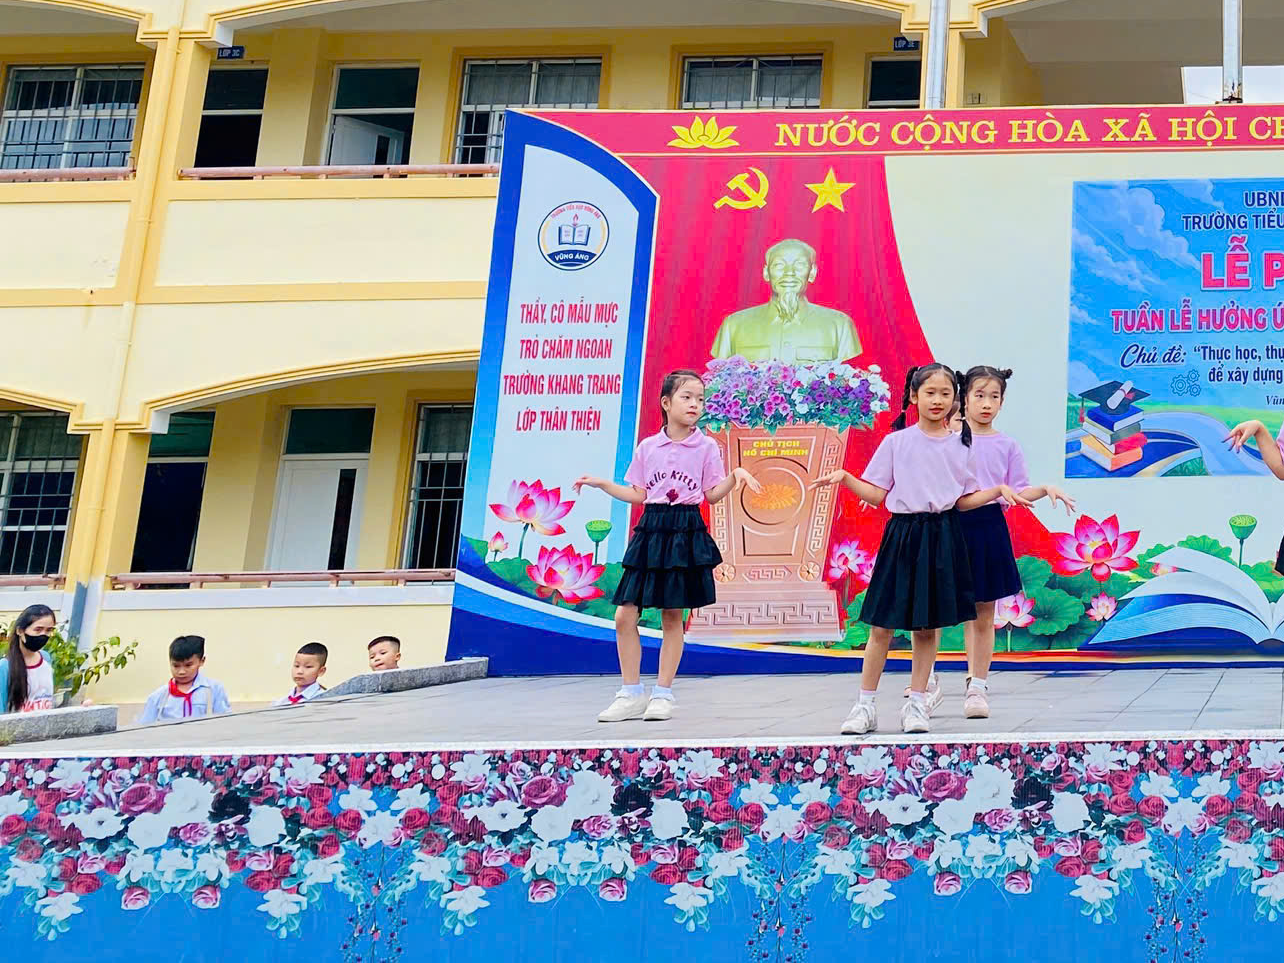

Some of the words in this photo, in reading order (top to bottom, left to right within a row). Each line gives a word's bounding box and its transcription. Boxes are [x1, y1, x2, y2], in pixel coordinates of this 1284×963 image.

[775, 116, 881, 147] NƯỚC
[890, 114, 998, 151] CỘNG
[1007, 111, 1090, 143] HÒA
[1102, 112, 1157, 142] XÃ
[1168, 110, 1237, 147] HỘI
[1182, 210, 1248, 231] TRƯỜNG
[1201, 235, 1250, 287] LỄ
[550, 299, 565, 323] CÔ
[567, 295, 592, 323] MẪU
[594, 302, 619, 328] MỰC
[1111, 301, 1164, 332] TUẦN
[1169, 299, 1192, 331] LỄ
[1197, 301, 1267, 330] HƯỞNG
[520, 334, 539, 359] TRÒ
[541, 335, 573, 359] CHĂM
[575, 339, 613, 359] NGOAN
[1121, 343, 1157, 368] Chủ
[1162, 344, 1187, 363] đề:
[1193, 344, 1231, 365] “Thực
[1235, 344, 1262, 362] học,
[503, 369, 545, 395] TRƯỜNG
[547, 374, 584, 394] KHANG
[587, 374, 621, 395] TRANG
[1208, 363, 1223, 382] để
[1227, 366, 1248, 385] xây
[1252, 366, 1283, 385] dựng
[516, 406, 537, 431] LỚP
[540, 406, 567, 431] THÂN
[571, 406, 601, 436] THIỆN
[670, 470, 698, 491] Kitty
